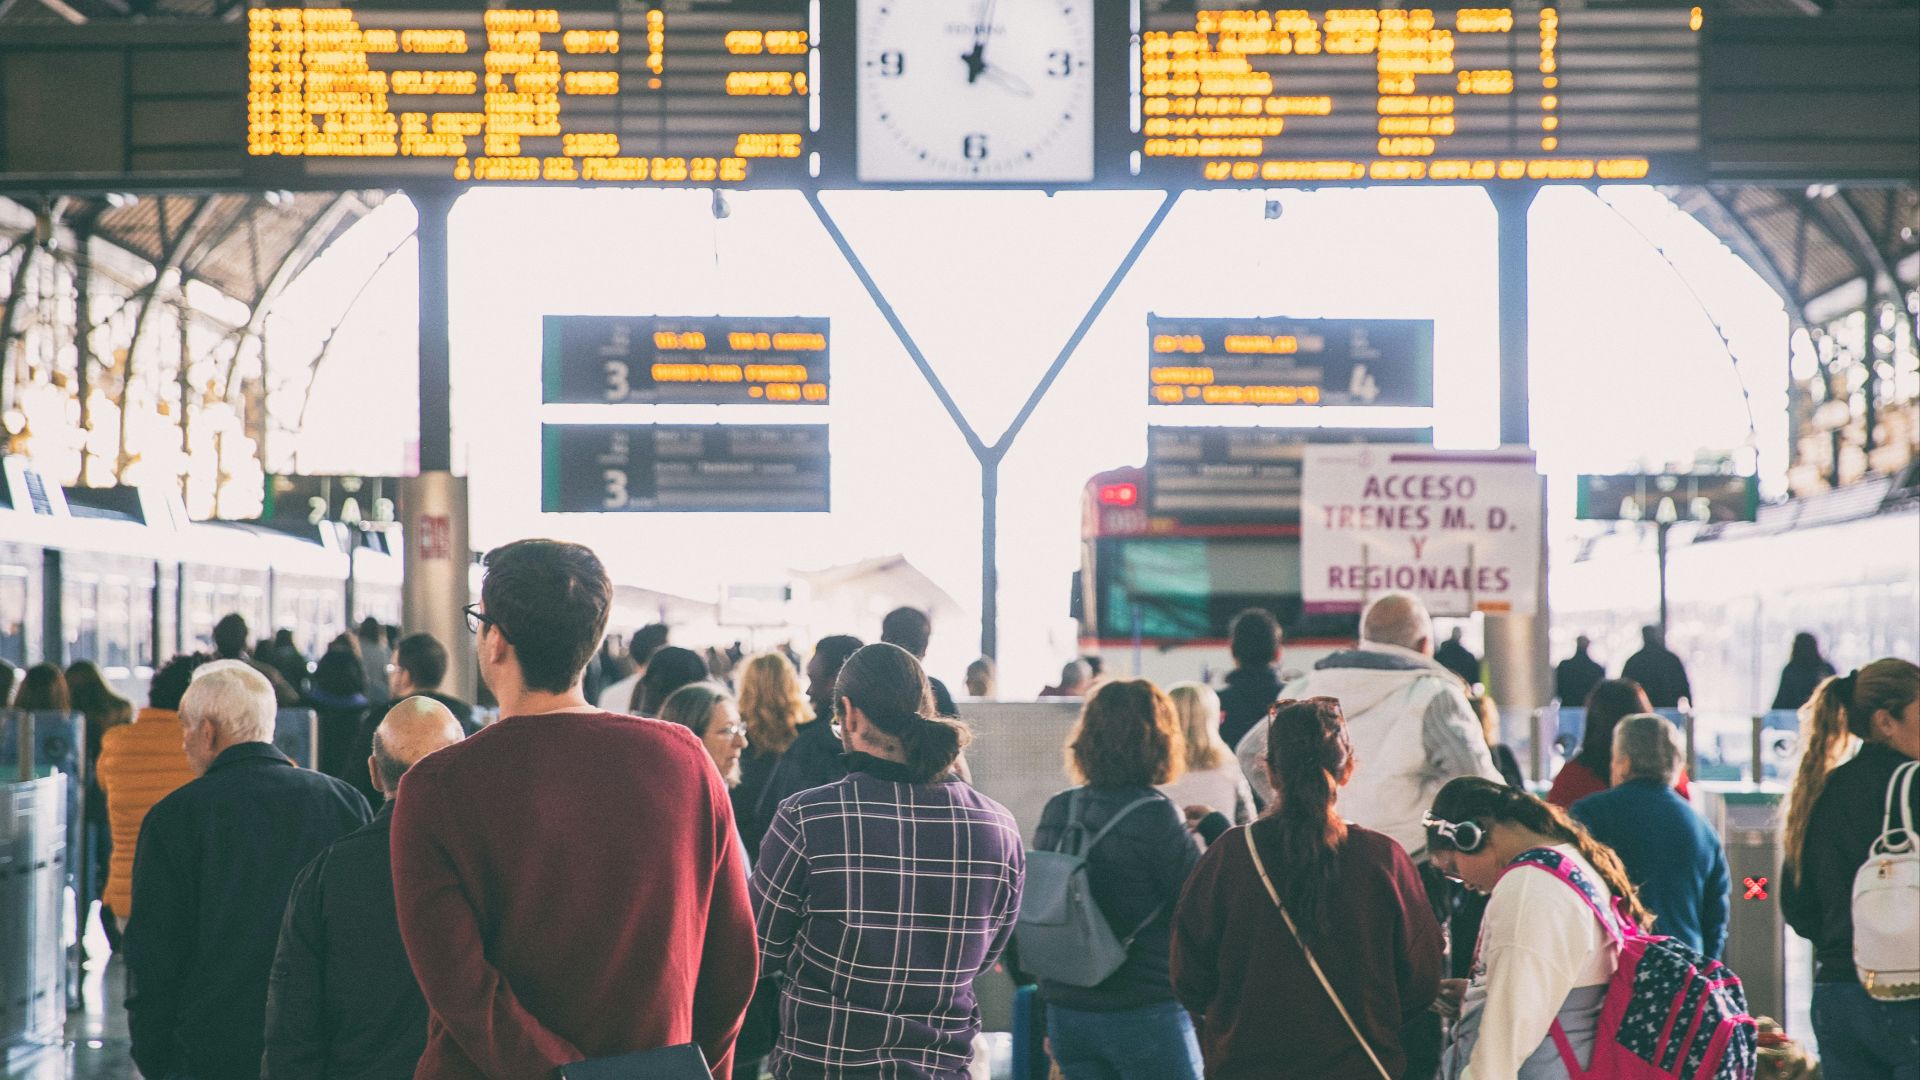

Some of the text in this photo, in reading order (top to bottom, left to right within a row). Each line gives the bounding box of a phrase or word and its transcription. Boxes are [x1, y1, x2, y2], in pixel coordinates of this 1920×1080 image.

[880, 51, 904, 77] 9
[1047, 51, 1071, 77] 3
[963, 133, 988, 160] 6
[605, 360, 629, 400] 3
[1349, 364, 1381, 402] 4
[603, 470, 628, 508] 3
[1363, 475, 1477, 500] ACCESO
[1323, 505, 1517, 531] TRENES M. D.
[1409, 535, 1428, 560] Y
[1327, 565, 1511, 592] REGIONALES
